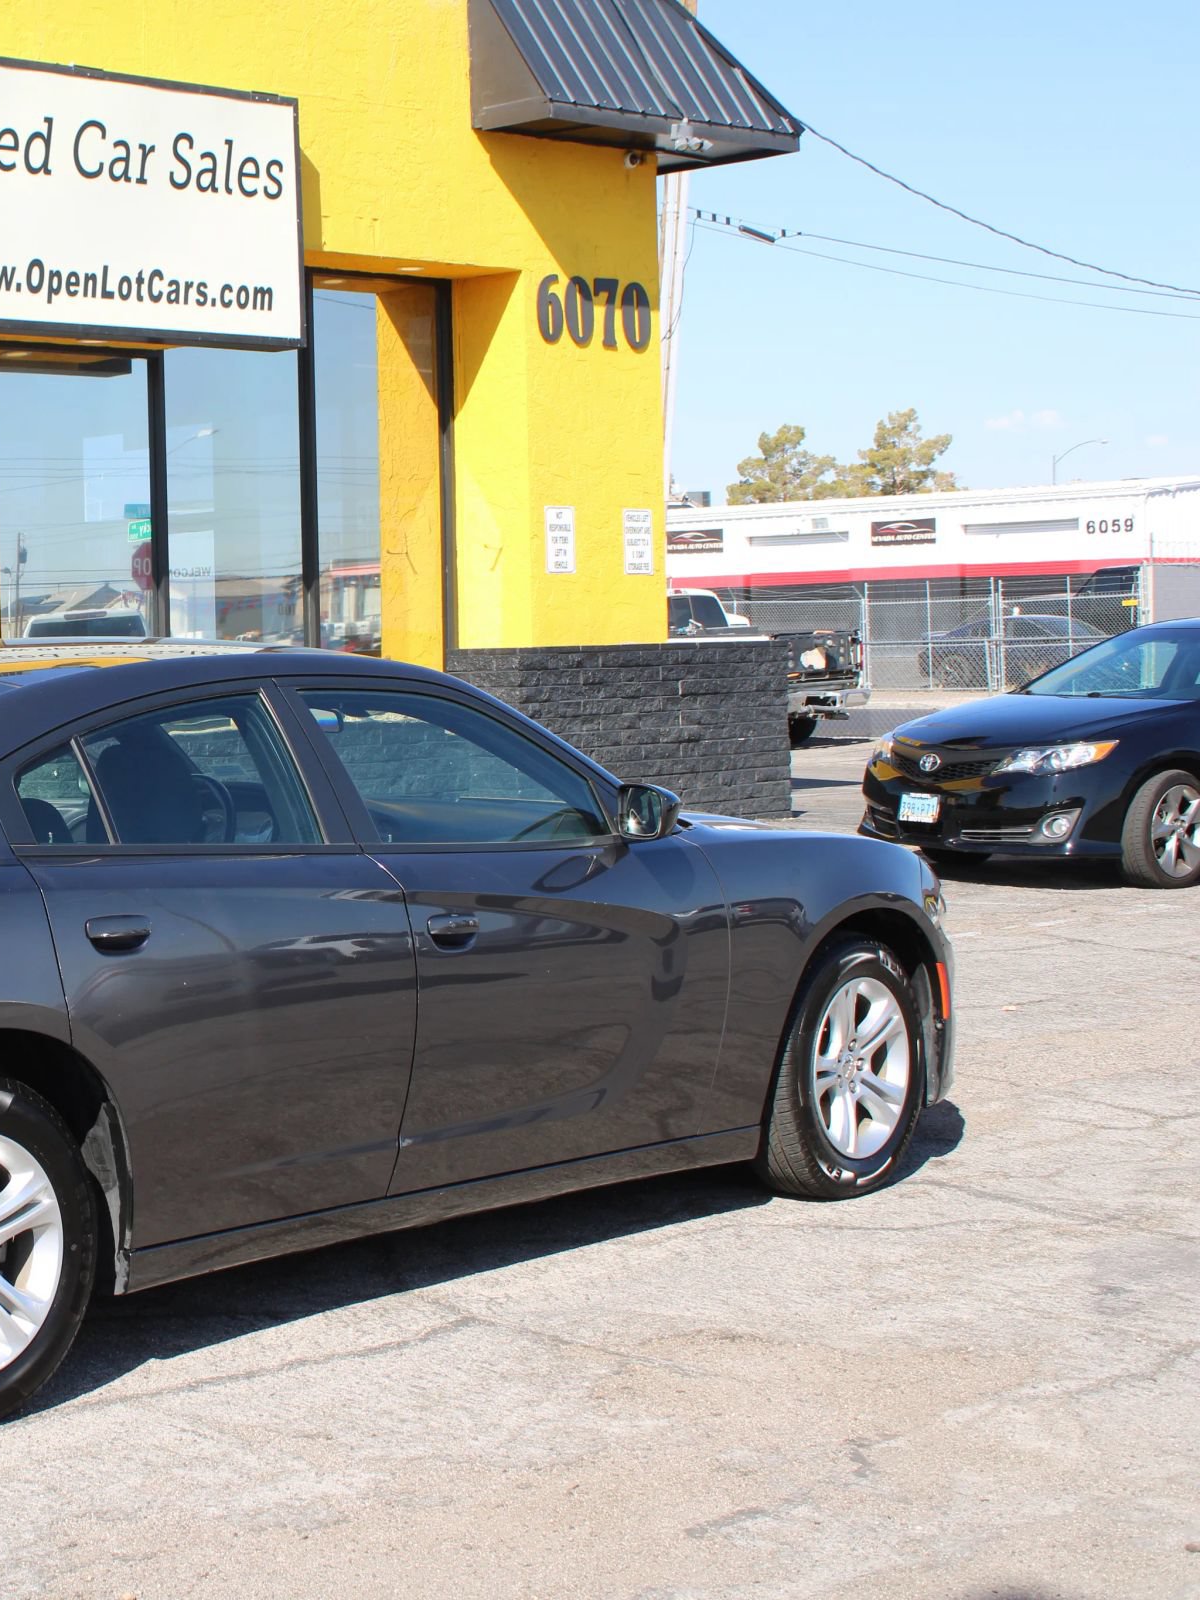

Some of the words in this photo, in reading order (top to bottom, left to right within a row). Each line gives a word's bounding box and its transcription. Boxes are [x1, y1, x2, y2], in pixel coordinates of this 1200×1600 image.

[72, 120, 156, 184] Car
[169, 133, 284, 199] Sales
[536, 274, 652, 351] 6070
[1086, 518, 1134, 534] 6059
